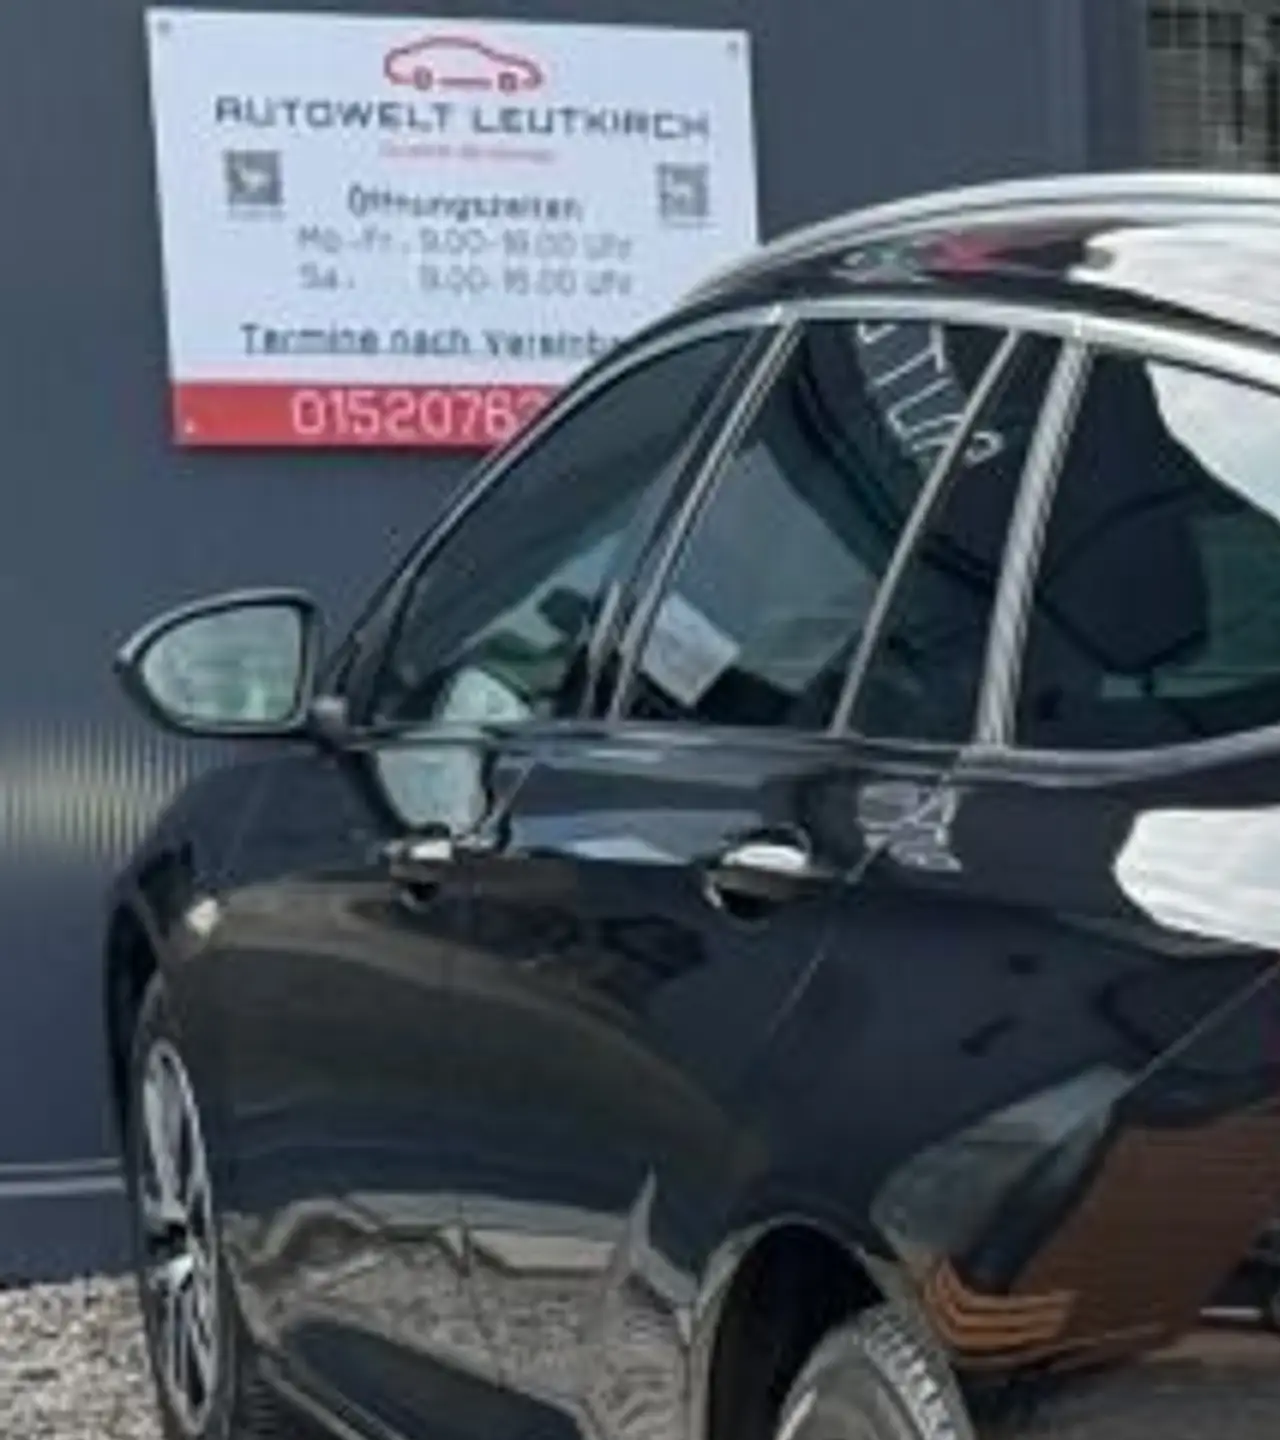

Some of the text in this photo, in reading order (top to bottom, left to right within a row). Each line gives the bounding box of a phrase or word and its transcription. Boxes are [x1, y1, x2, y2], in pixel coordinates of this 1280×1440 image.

[215, 96, 710, 140] AUTOWELT LEUTKIRCH
[240, 323, 378, 357] Termine
[390, 328, 470, 357] nach
